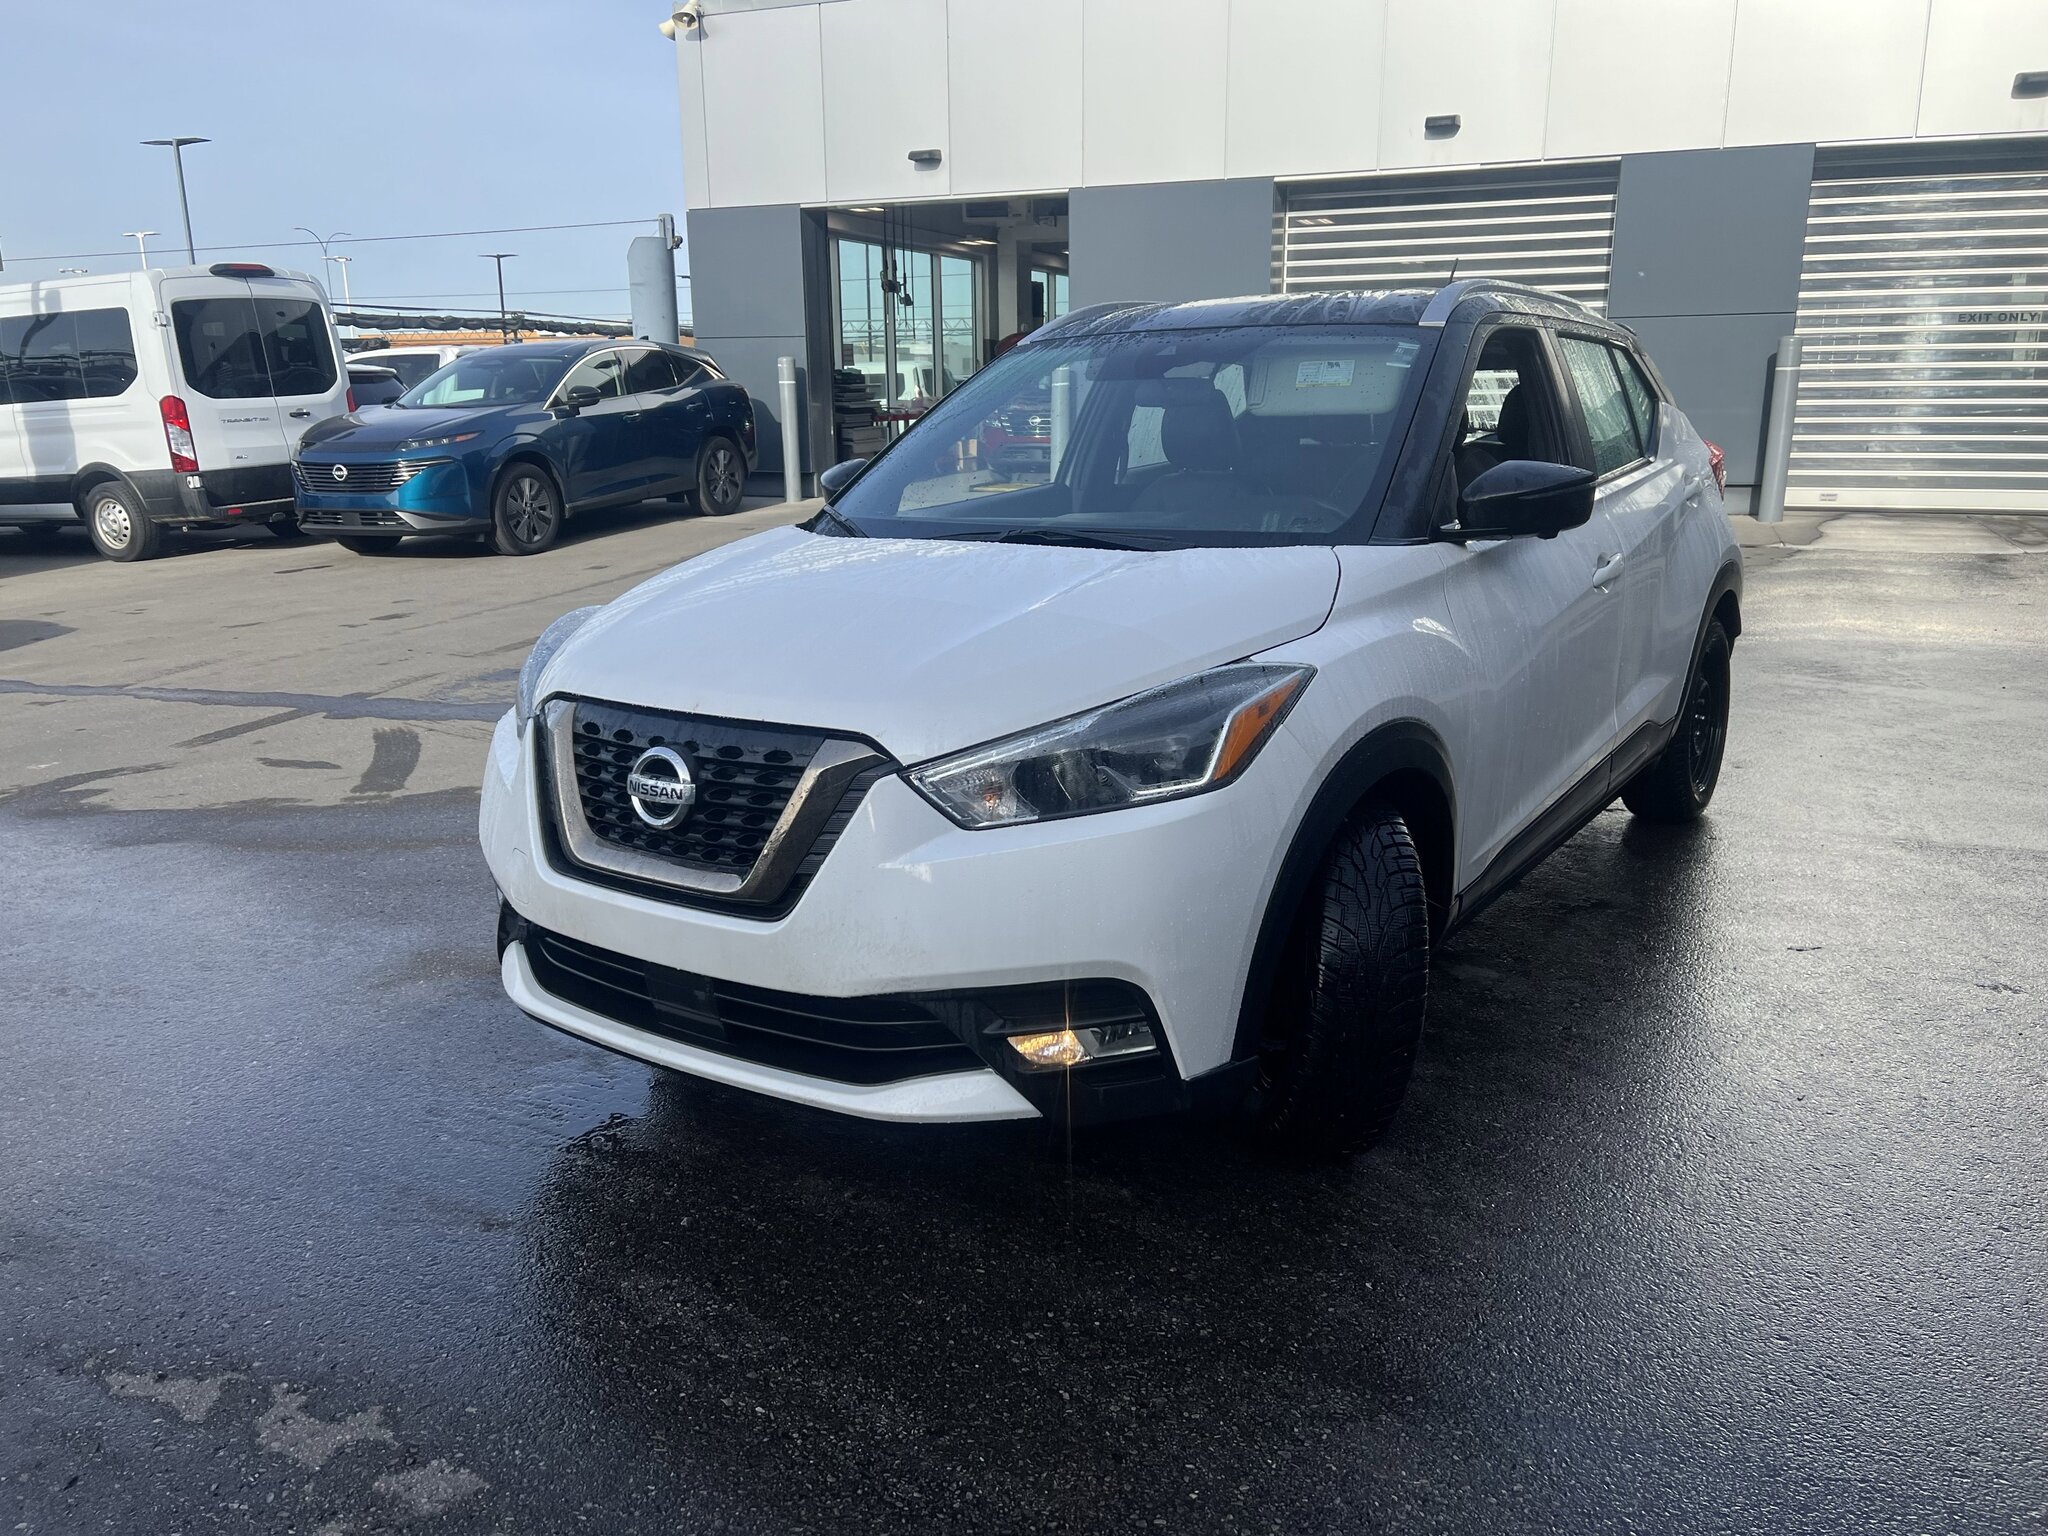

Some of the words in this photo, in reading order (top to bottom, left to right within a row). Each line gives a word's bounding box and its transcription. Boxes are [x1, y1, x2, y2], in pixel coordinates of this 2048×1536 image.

[1958, 313, 1992, 323] EXIT
[1998, 312, 2038, 322] ONLY
[629, 780, 683, 800] NISSAN
